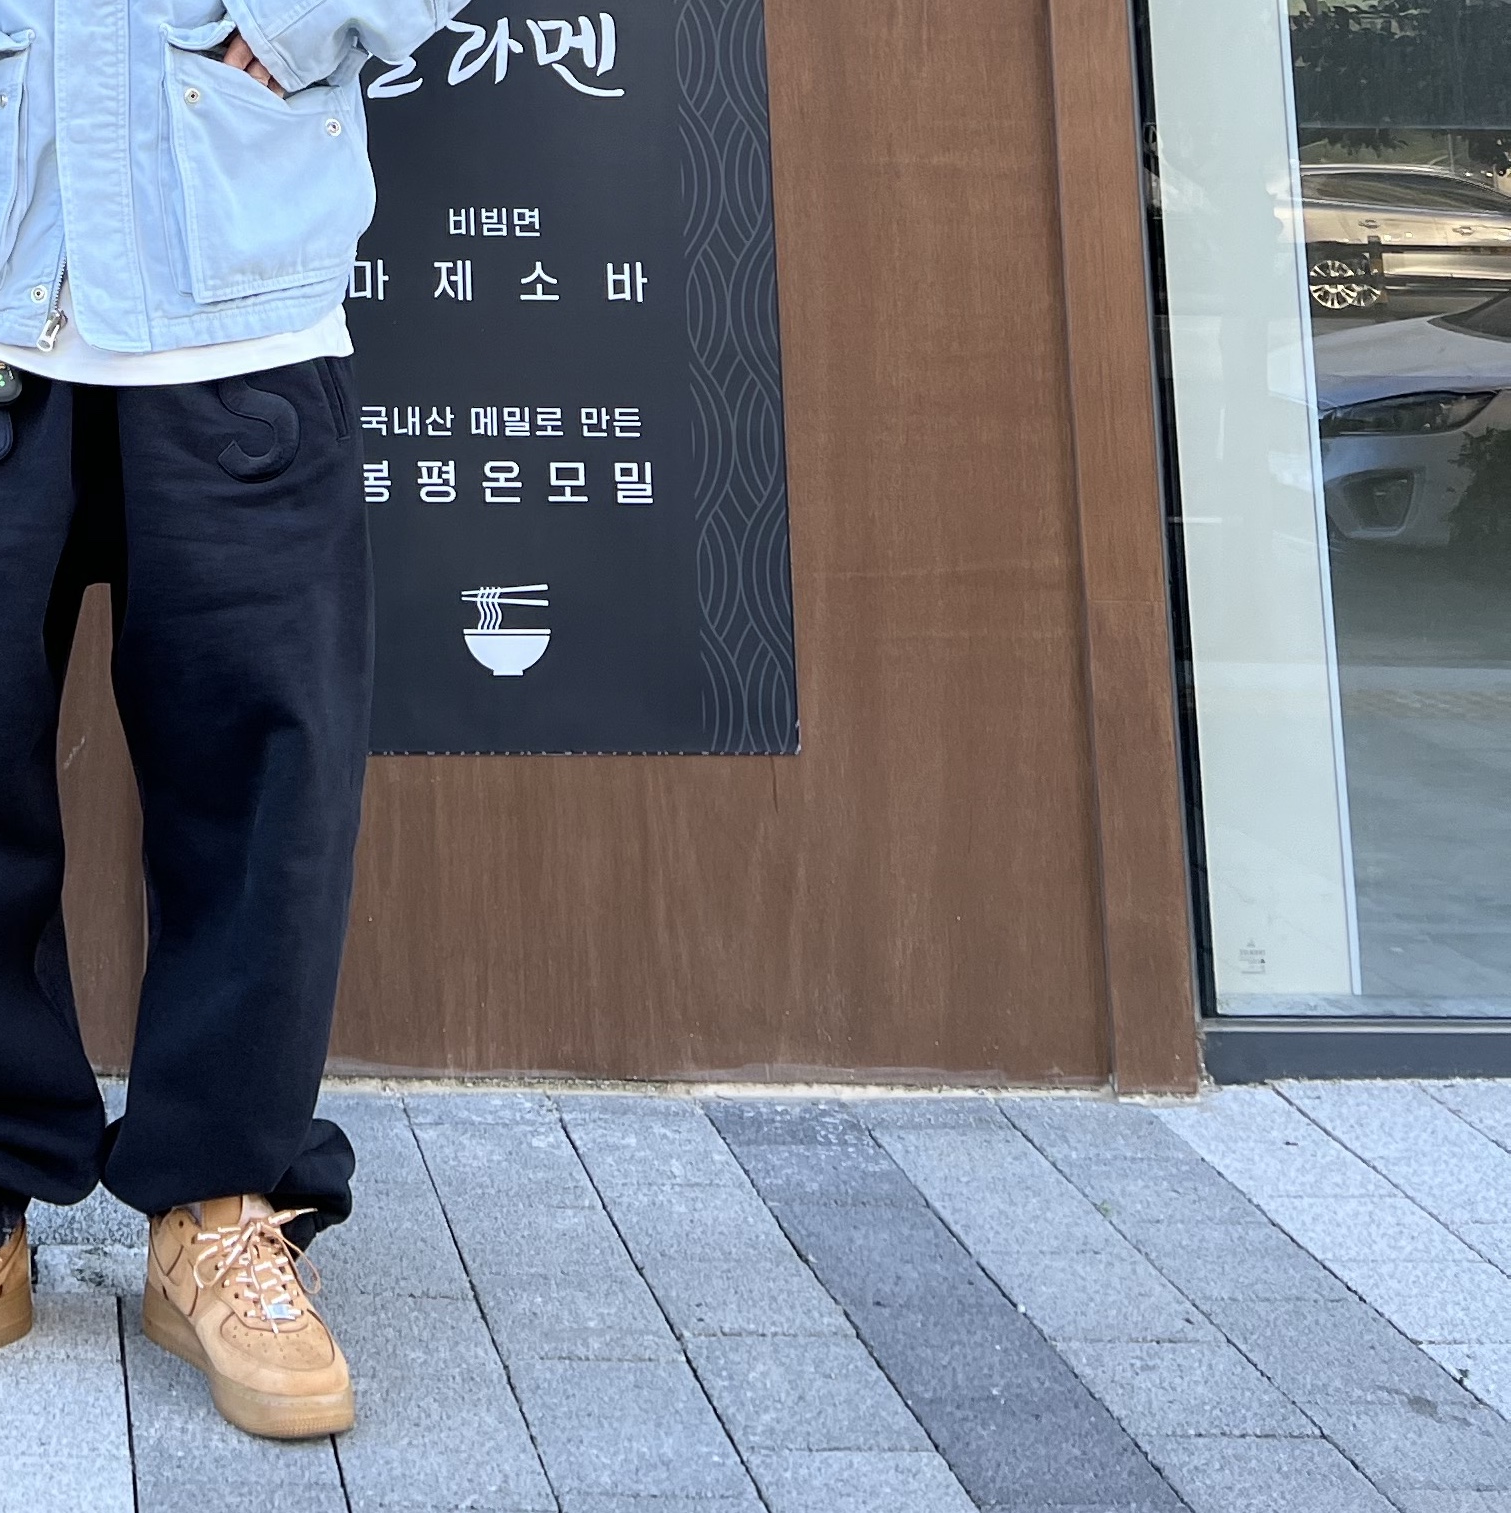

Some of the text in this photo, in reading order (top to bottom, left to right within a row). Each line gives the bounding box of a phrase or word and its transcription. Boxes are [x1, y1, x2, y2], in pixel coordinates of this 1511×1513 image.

[449, 206, 541, 237] 비빔면
[359, 405, 642, 438] 국내산 메밀로 만든
